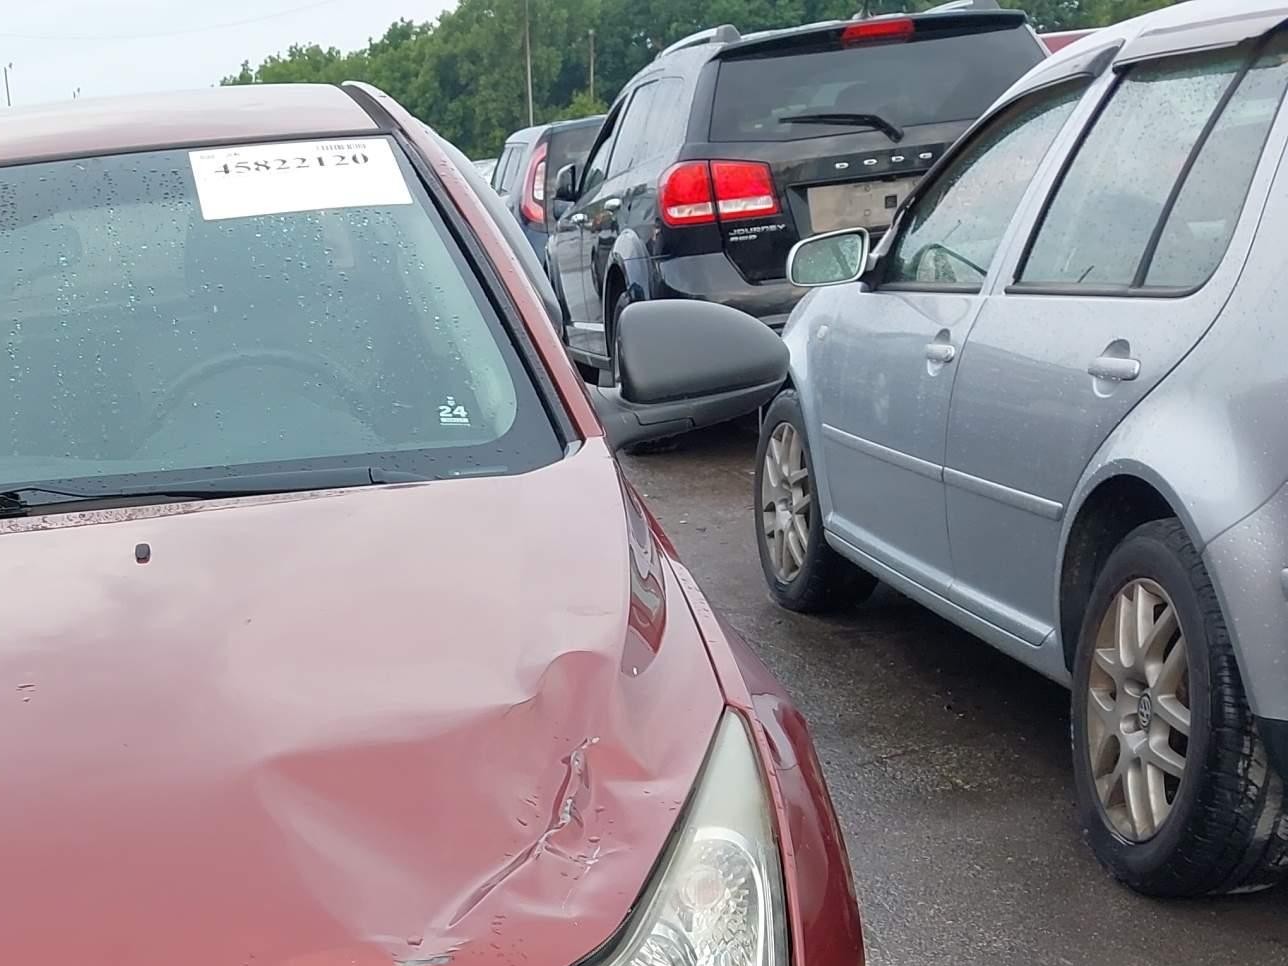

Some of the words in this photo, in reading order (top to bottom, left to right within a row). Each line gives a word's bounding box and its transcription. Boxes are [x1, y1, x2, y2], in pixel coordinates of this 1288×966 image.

[214, 153, 369, 174] 45822120
[835, 152, 933, 169] DODG
[439, 405, 468, 417] 24
